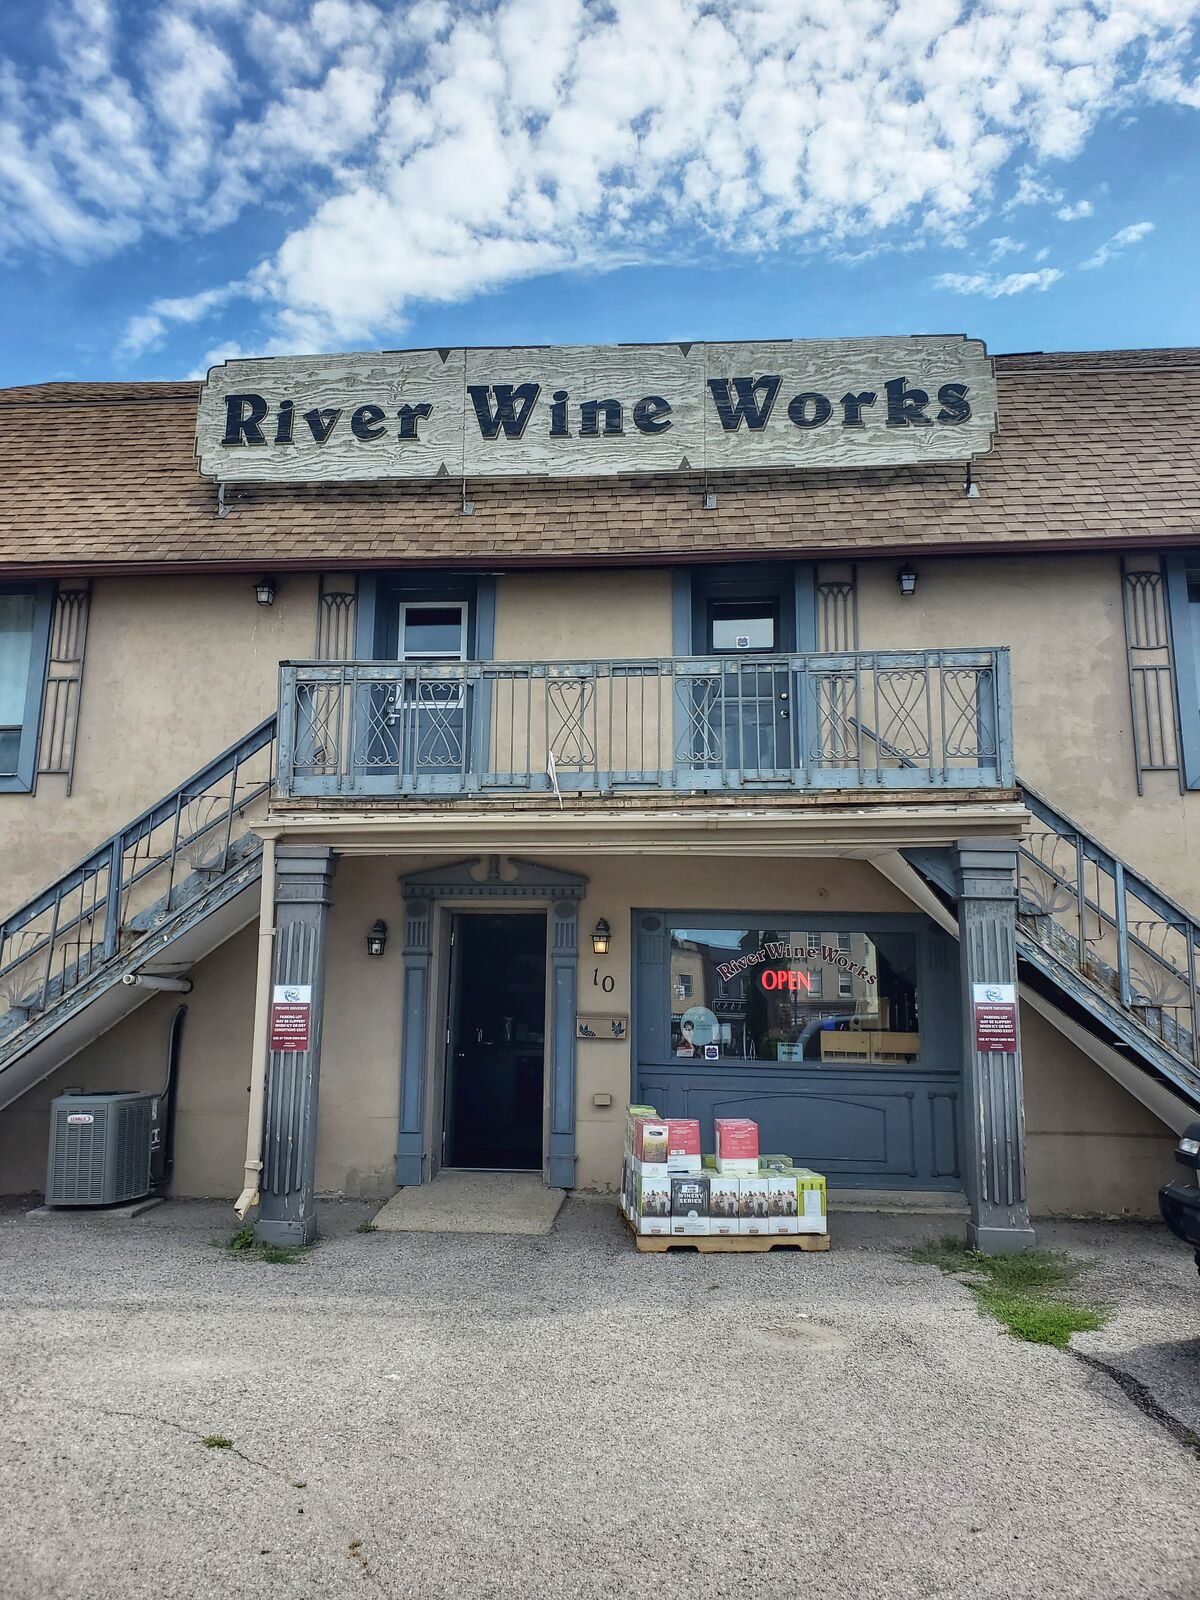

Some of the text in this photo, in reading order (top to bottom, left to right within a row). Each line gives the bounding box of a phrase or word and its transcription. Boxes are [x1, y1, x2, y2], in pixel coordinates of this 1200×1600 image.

[222, 374, 973, 447] River Wine Works
[593, 967, 615, 993] 10
[716, 941, 877, 985] River Wine Works
[761, 969, 811, 990] OPEN
